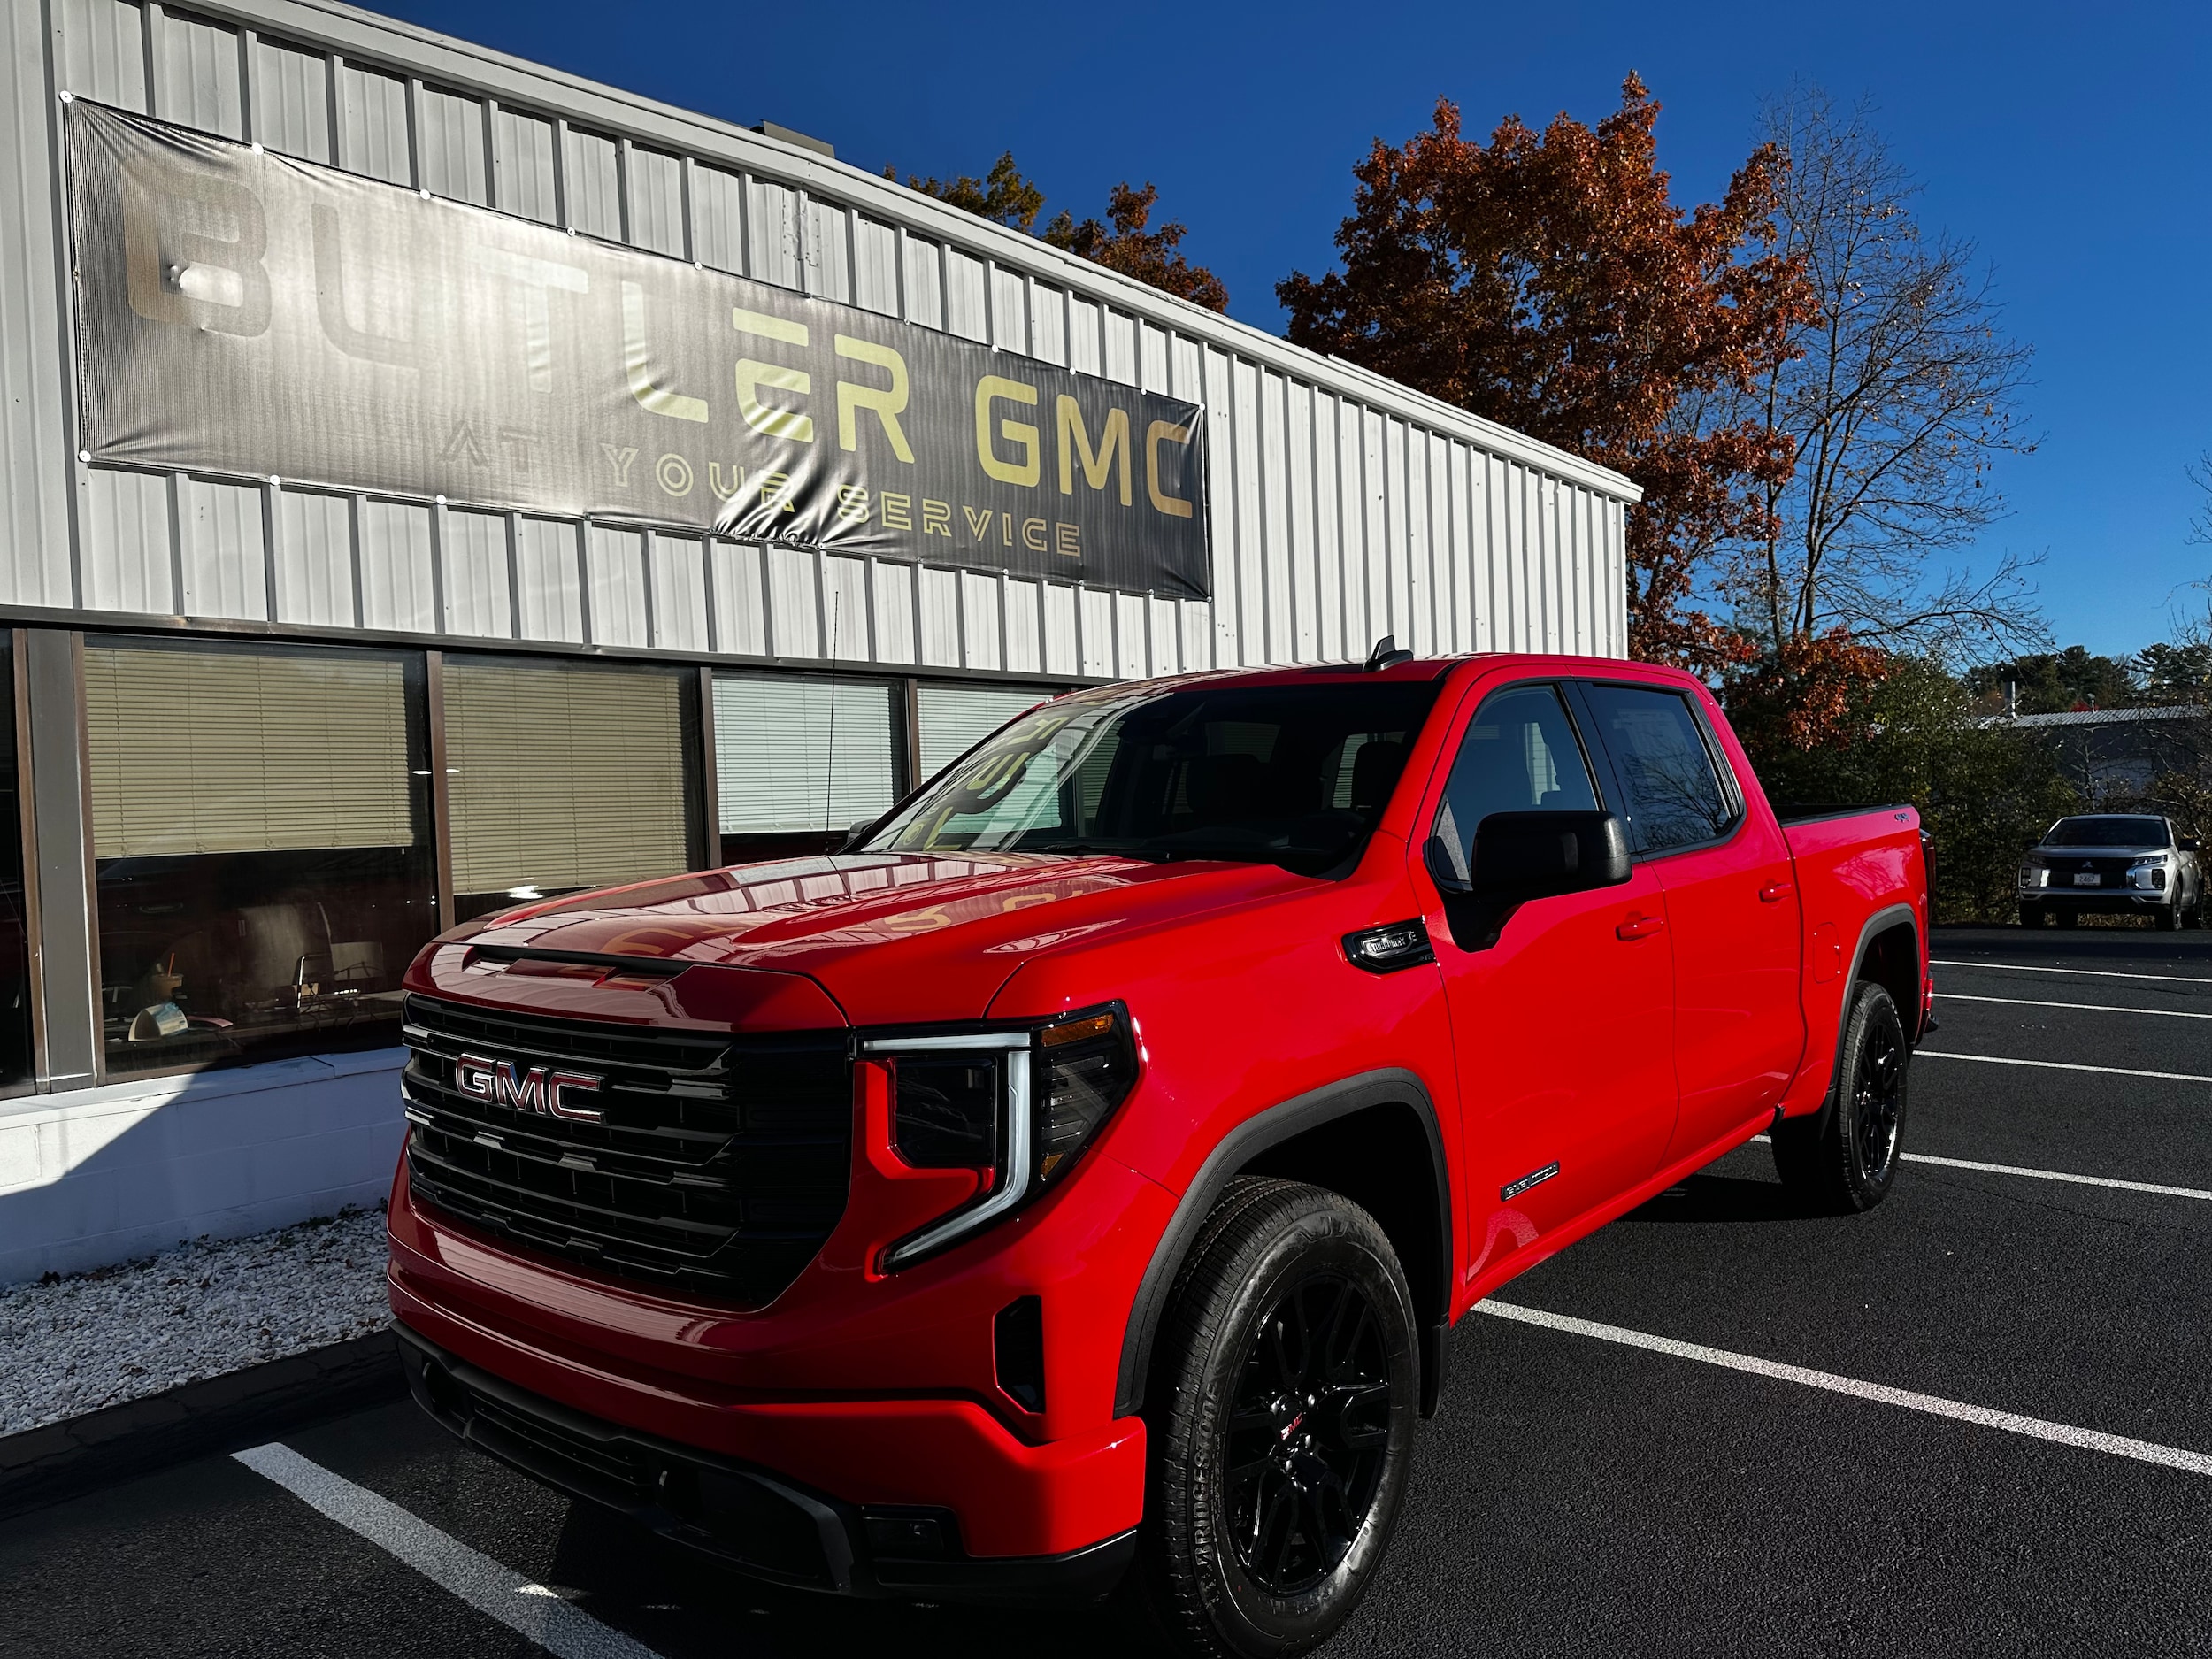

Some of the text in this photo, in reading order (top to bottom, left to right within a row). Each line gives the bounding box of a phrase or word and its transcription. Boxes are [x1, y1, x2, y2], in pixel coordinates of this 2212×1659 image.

[121, 157, 1193, 518] BUTLER GMC
[440, 421, 1081, 557] AT YOUR SERVICE
[455, 1051, 605, 1125] GMC
